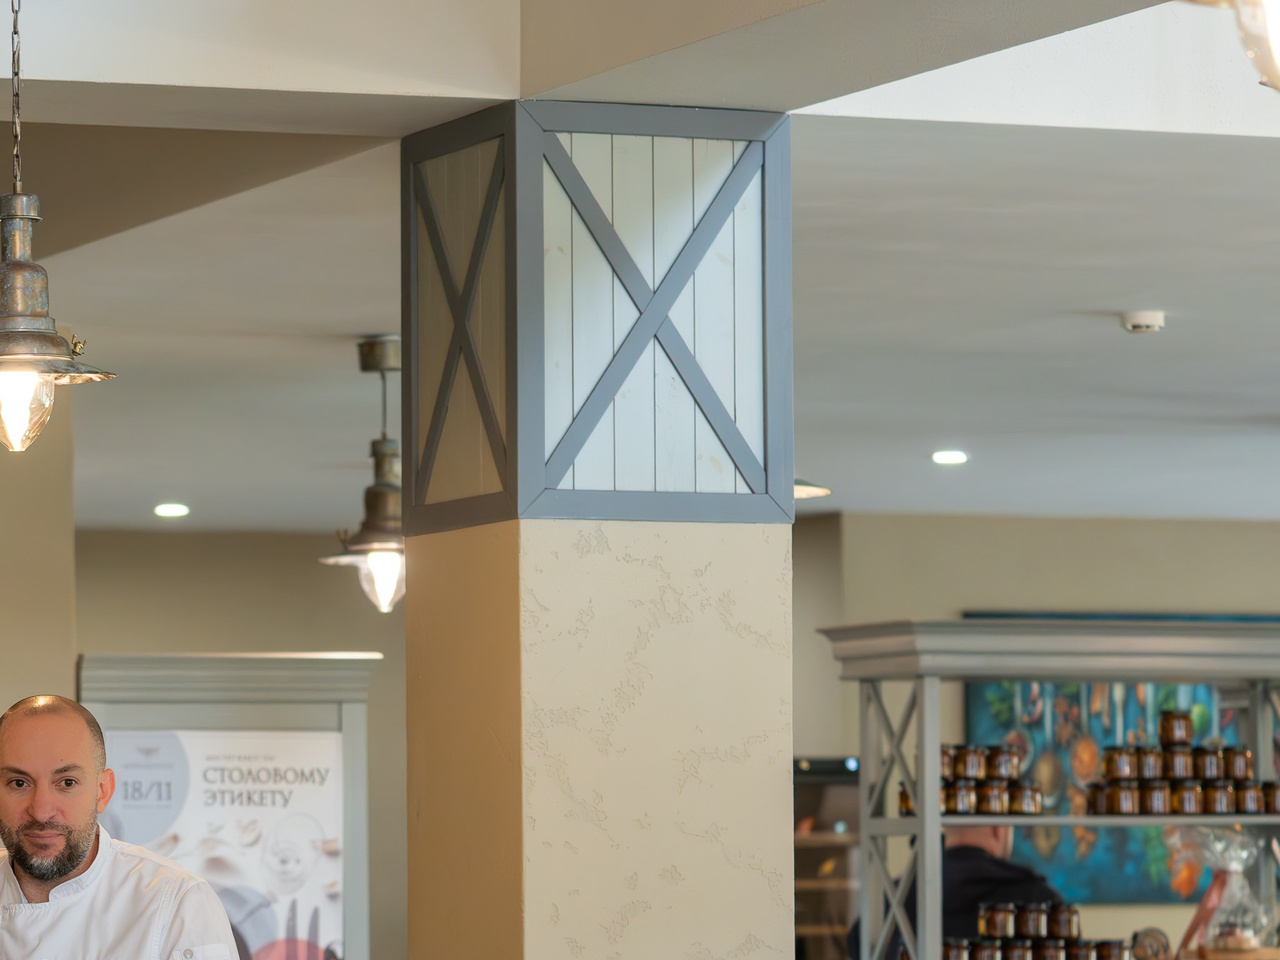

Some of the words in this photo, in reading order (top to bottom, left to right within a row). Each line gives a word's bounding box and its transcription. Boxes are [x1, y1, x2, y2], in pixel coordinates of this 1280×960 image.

[203, 766, 330, 787] СТОЛОВОМУ
[121, 780, 172, 801] 18/11
[203, 788, 293, 808] ЭТИКЕТУ
